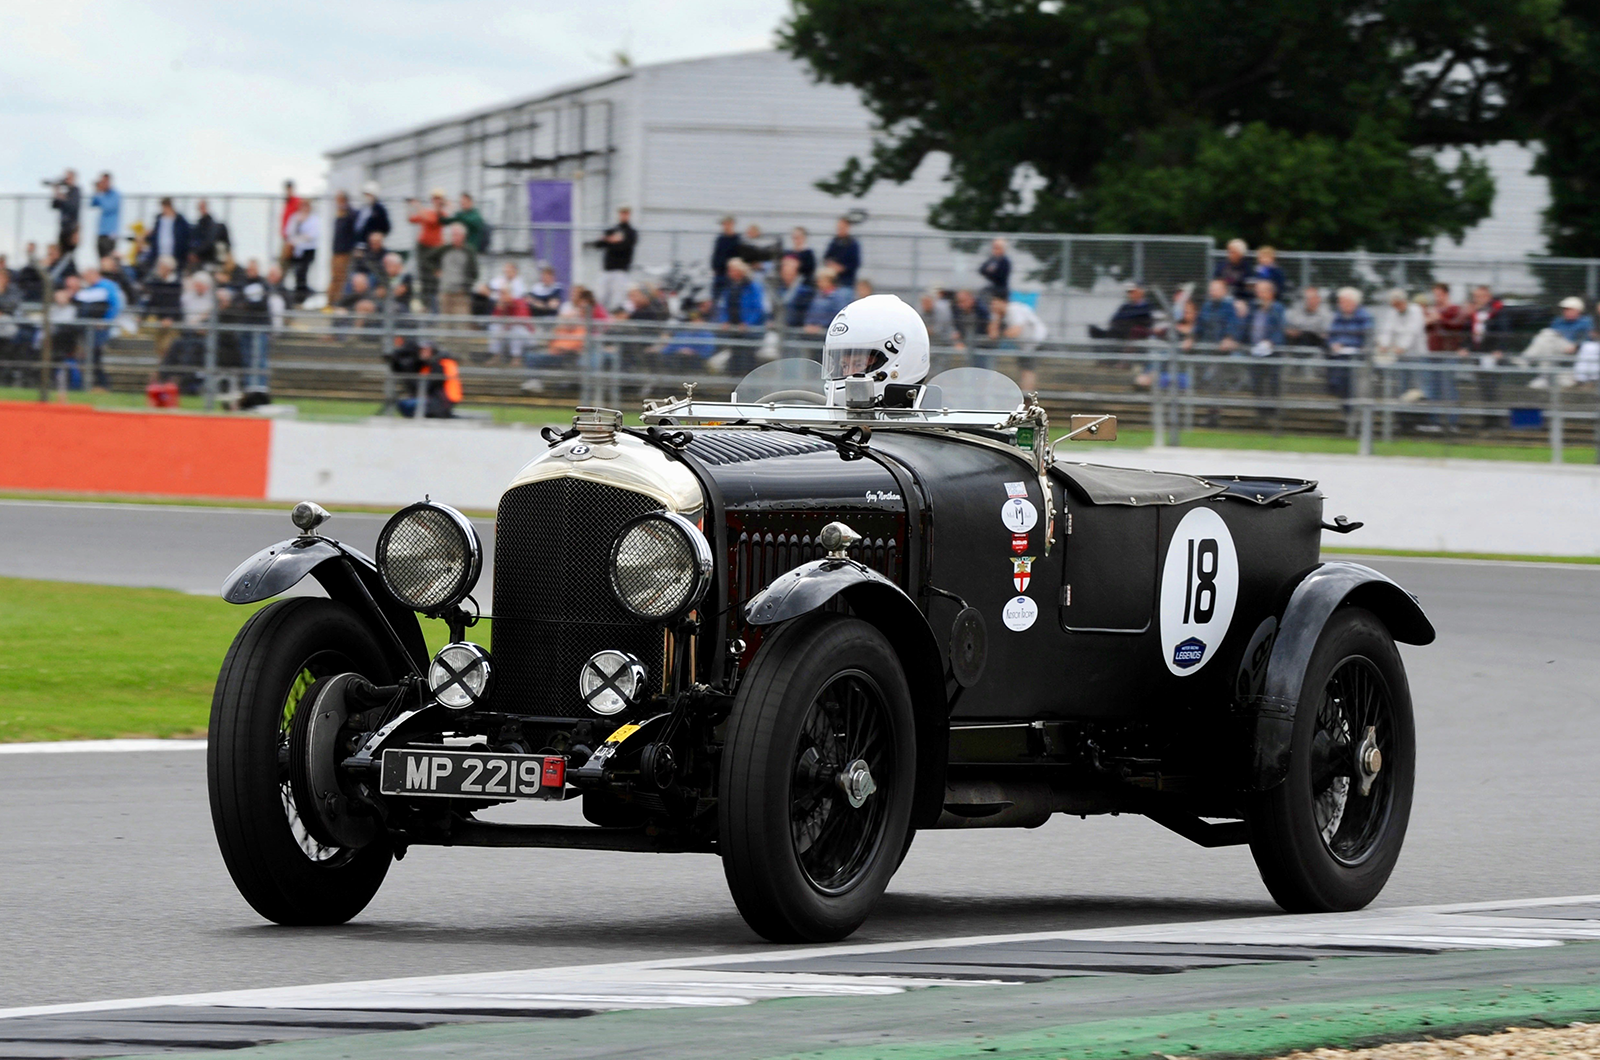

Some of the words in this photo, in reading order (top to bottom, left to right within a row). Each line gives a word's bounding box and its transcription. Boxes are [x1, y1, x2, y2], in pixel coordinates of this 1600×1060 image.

[573, 446, 587, 455] B
[1183, 538, 1219, 625] 18
[1175, 651, 1202, 660] LEGENDS
[405, 756, 453, 790] MP
[460, 758, 541, 795] 2219
